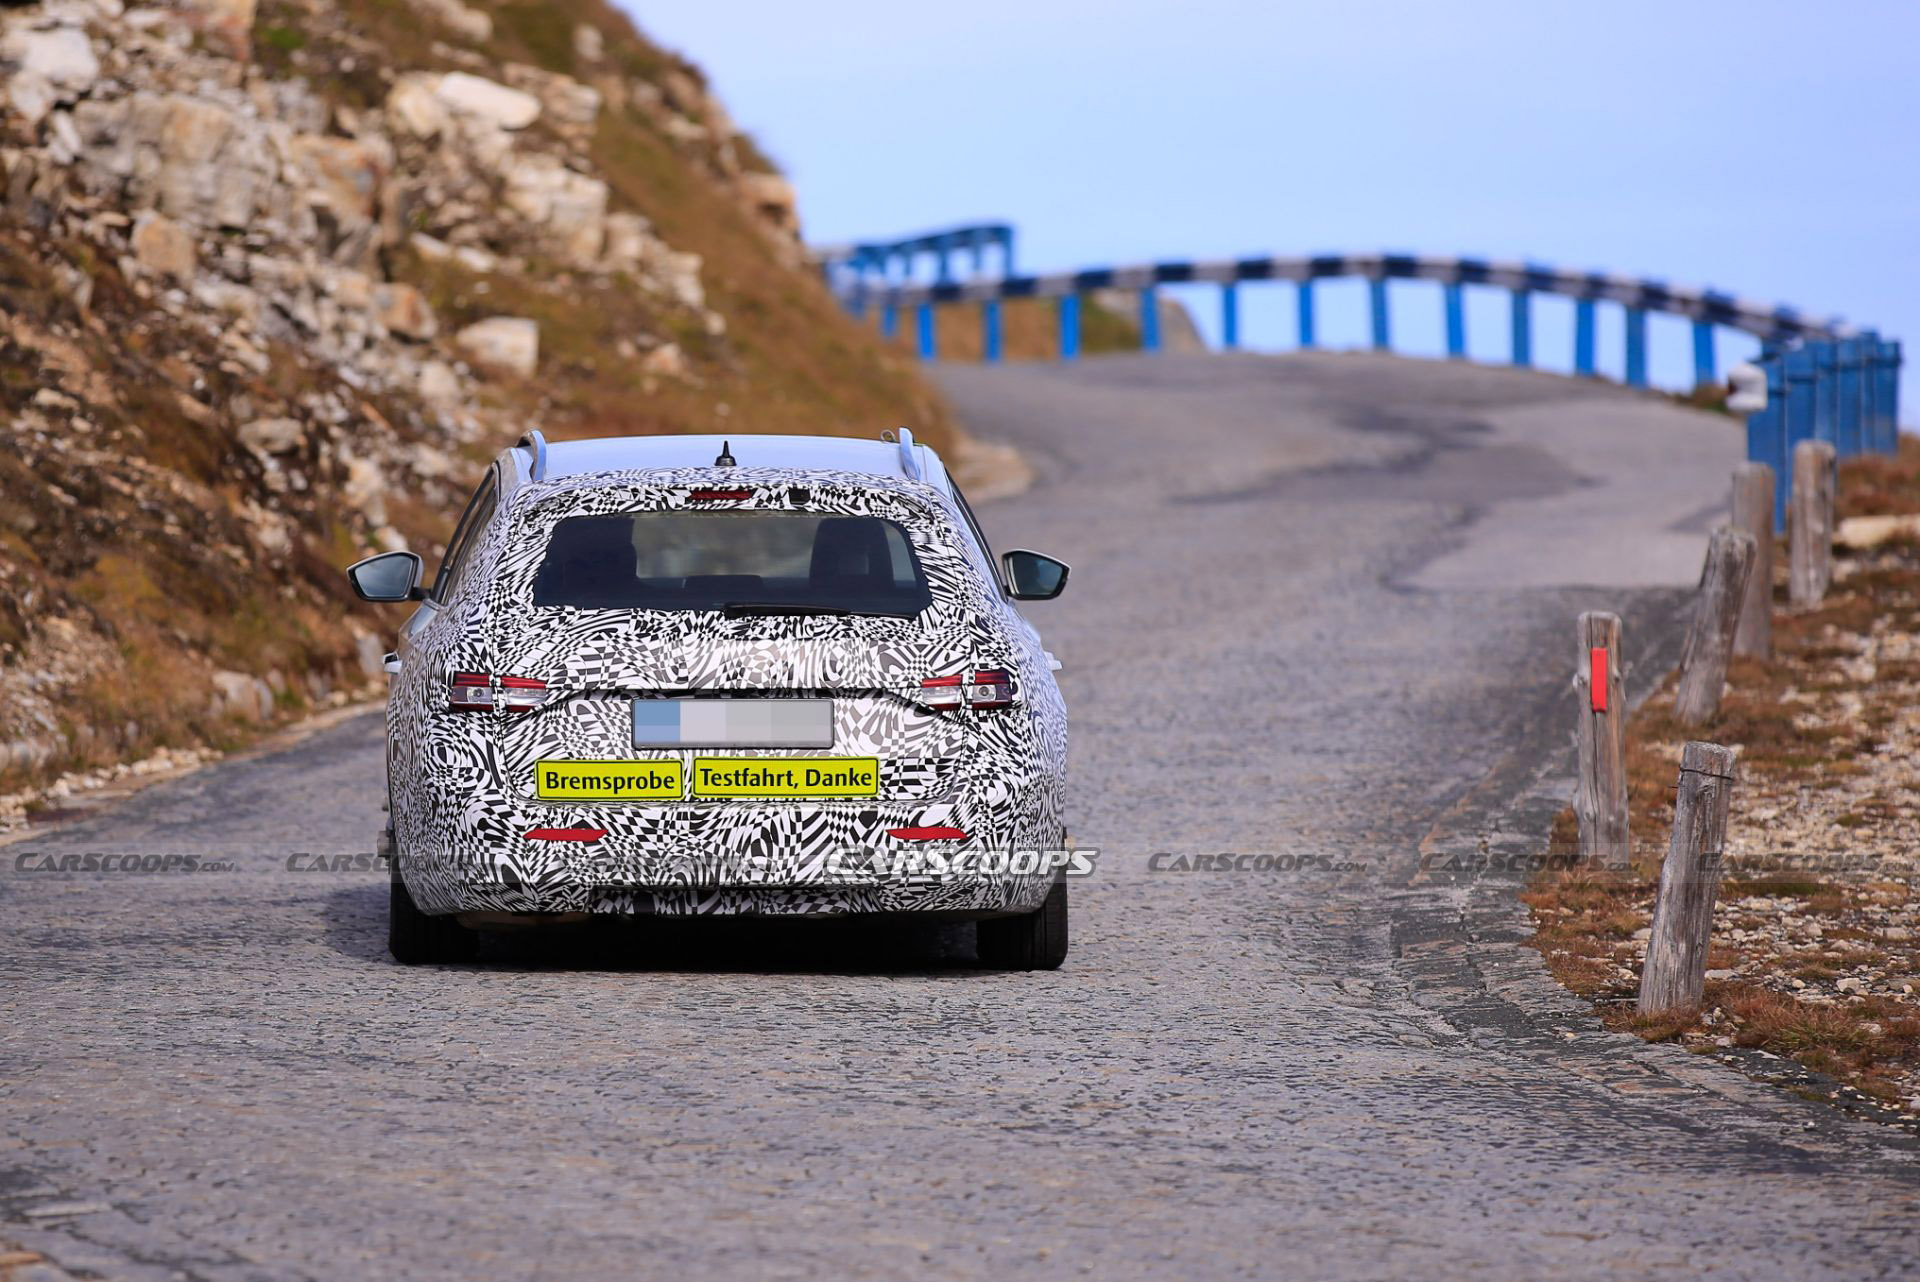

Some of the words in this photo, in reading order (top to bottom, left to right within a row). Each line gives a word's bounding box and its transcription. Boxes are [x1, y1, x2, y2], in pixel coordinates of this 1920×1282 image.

[545, 770, 675, 795] Bremsprobe
[699, 767, 799, 789] Testfahrt,
[805, 767, 872, 787] Danke
